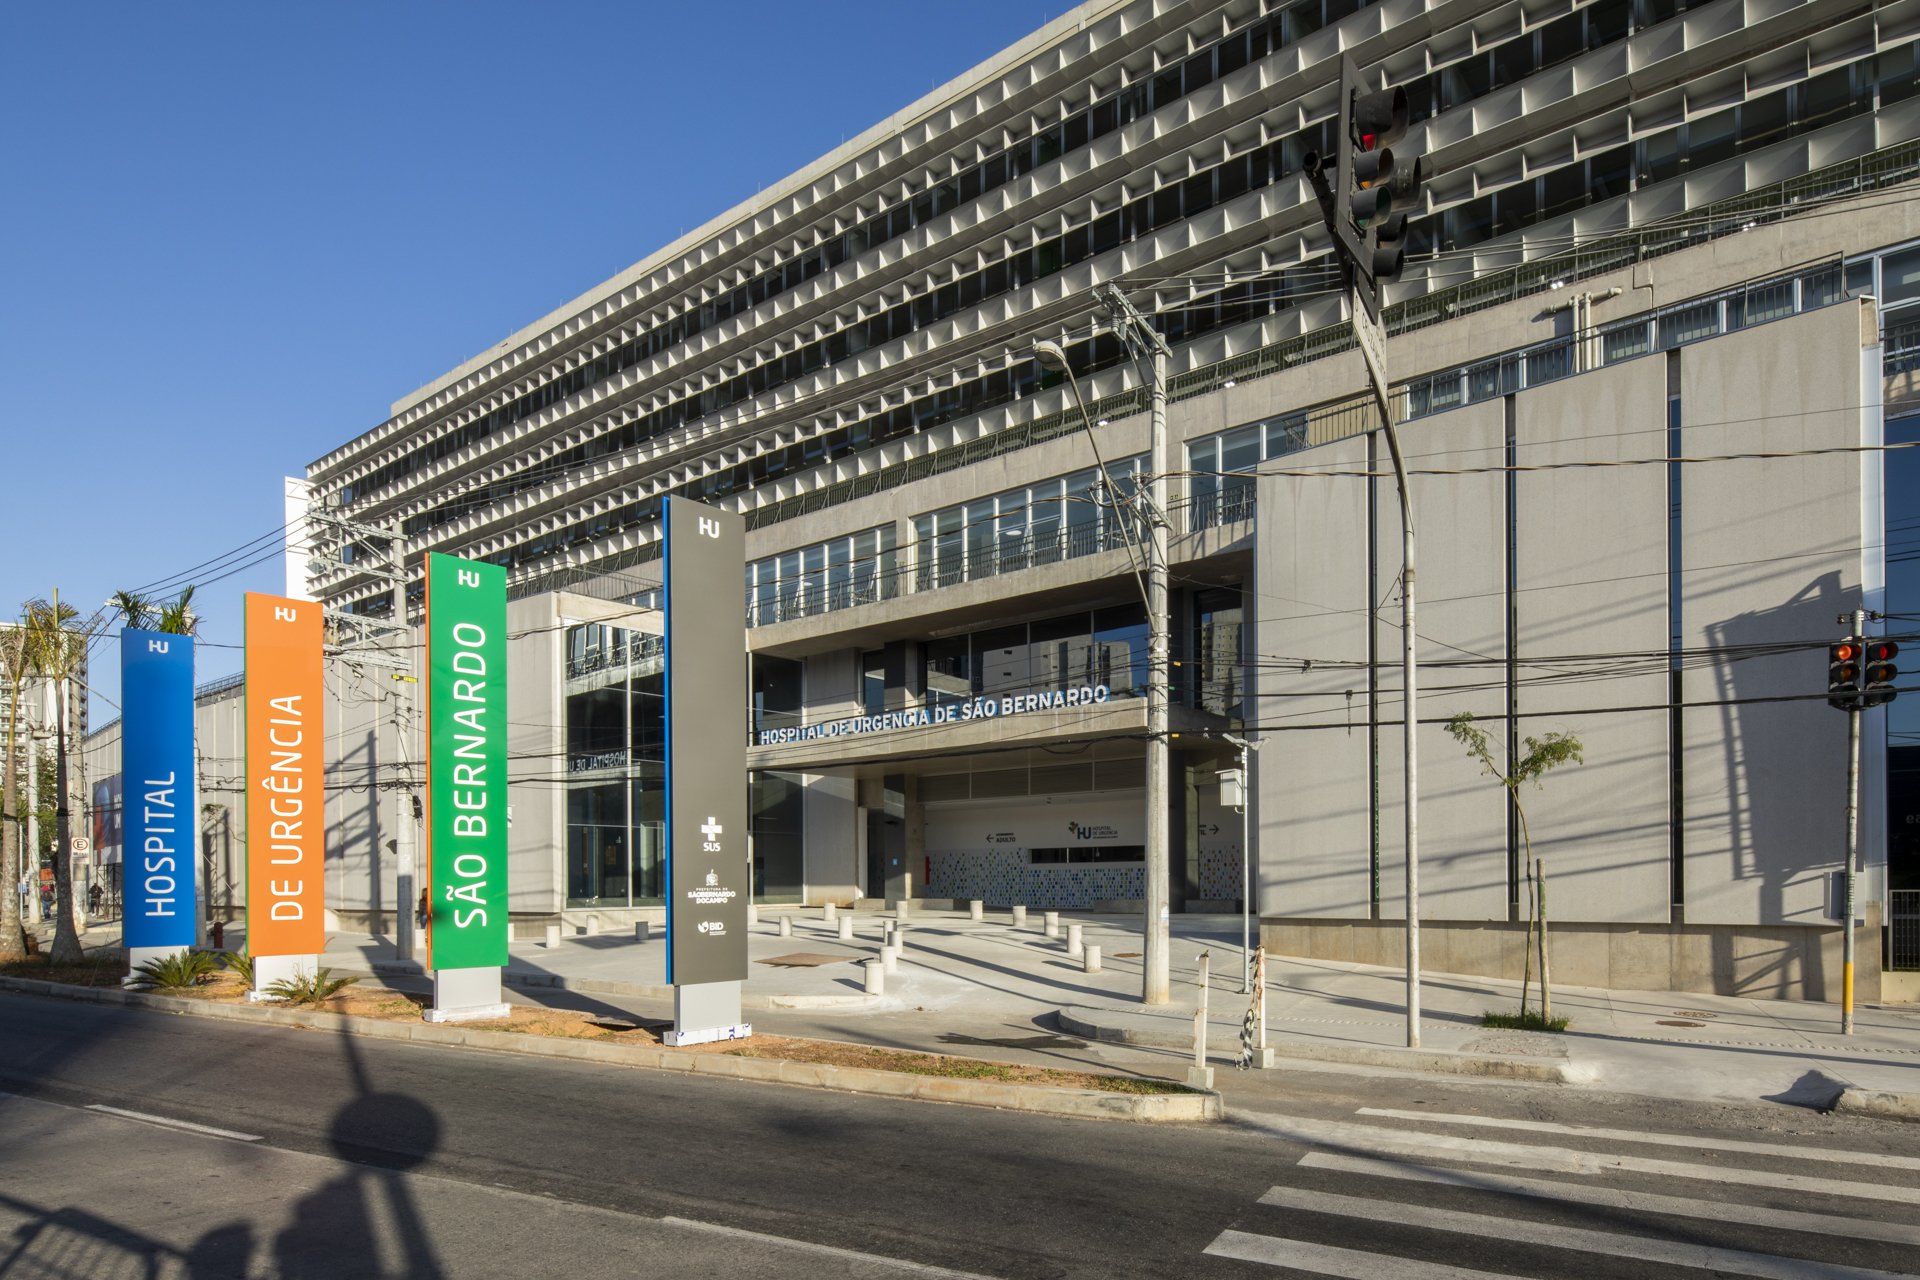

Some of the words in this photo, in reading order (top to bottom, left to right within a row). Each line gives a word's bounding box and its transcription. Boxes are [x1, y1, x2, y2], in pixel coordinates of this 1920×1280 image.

[699, 516, 720, 538] HU
[457, 569, 480, 588] HU
[274, 606, 296, 622] HU
[148, 640, 169, 654] HU
[453, 622, 487, 837] BERNARDO
[761, 723, 826, 745] HOSPITAL
[829, 719, 847, 737] DE
[935, 704, 957, 723] DE
[961, 697, 996, 721] SÃO
[1001, 684, 1107, 716] BERNARDO
[262, 695, 303, 865] URGÊNCIA
[145, 771, 176, 917] HOSPITAL
[703, 842, 720, 852] SUS
[271, 879, 303, 921] DE
[446, 854, 487, 929] SÃO
[709, 922, 724, 930] BID
